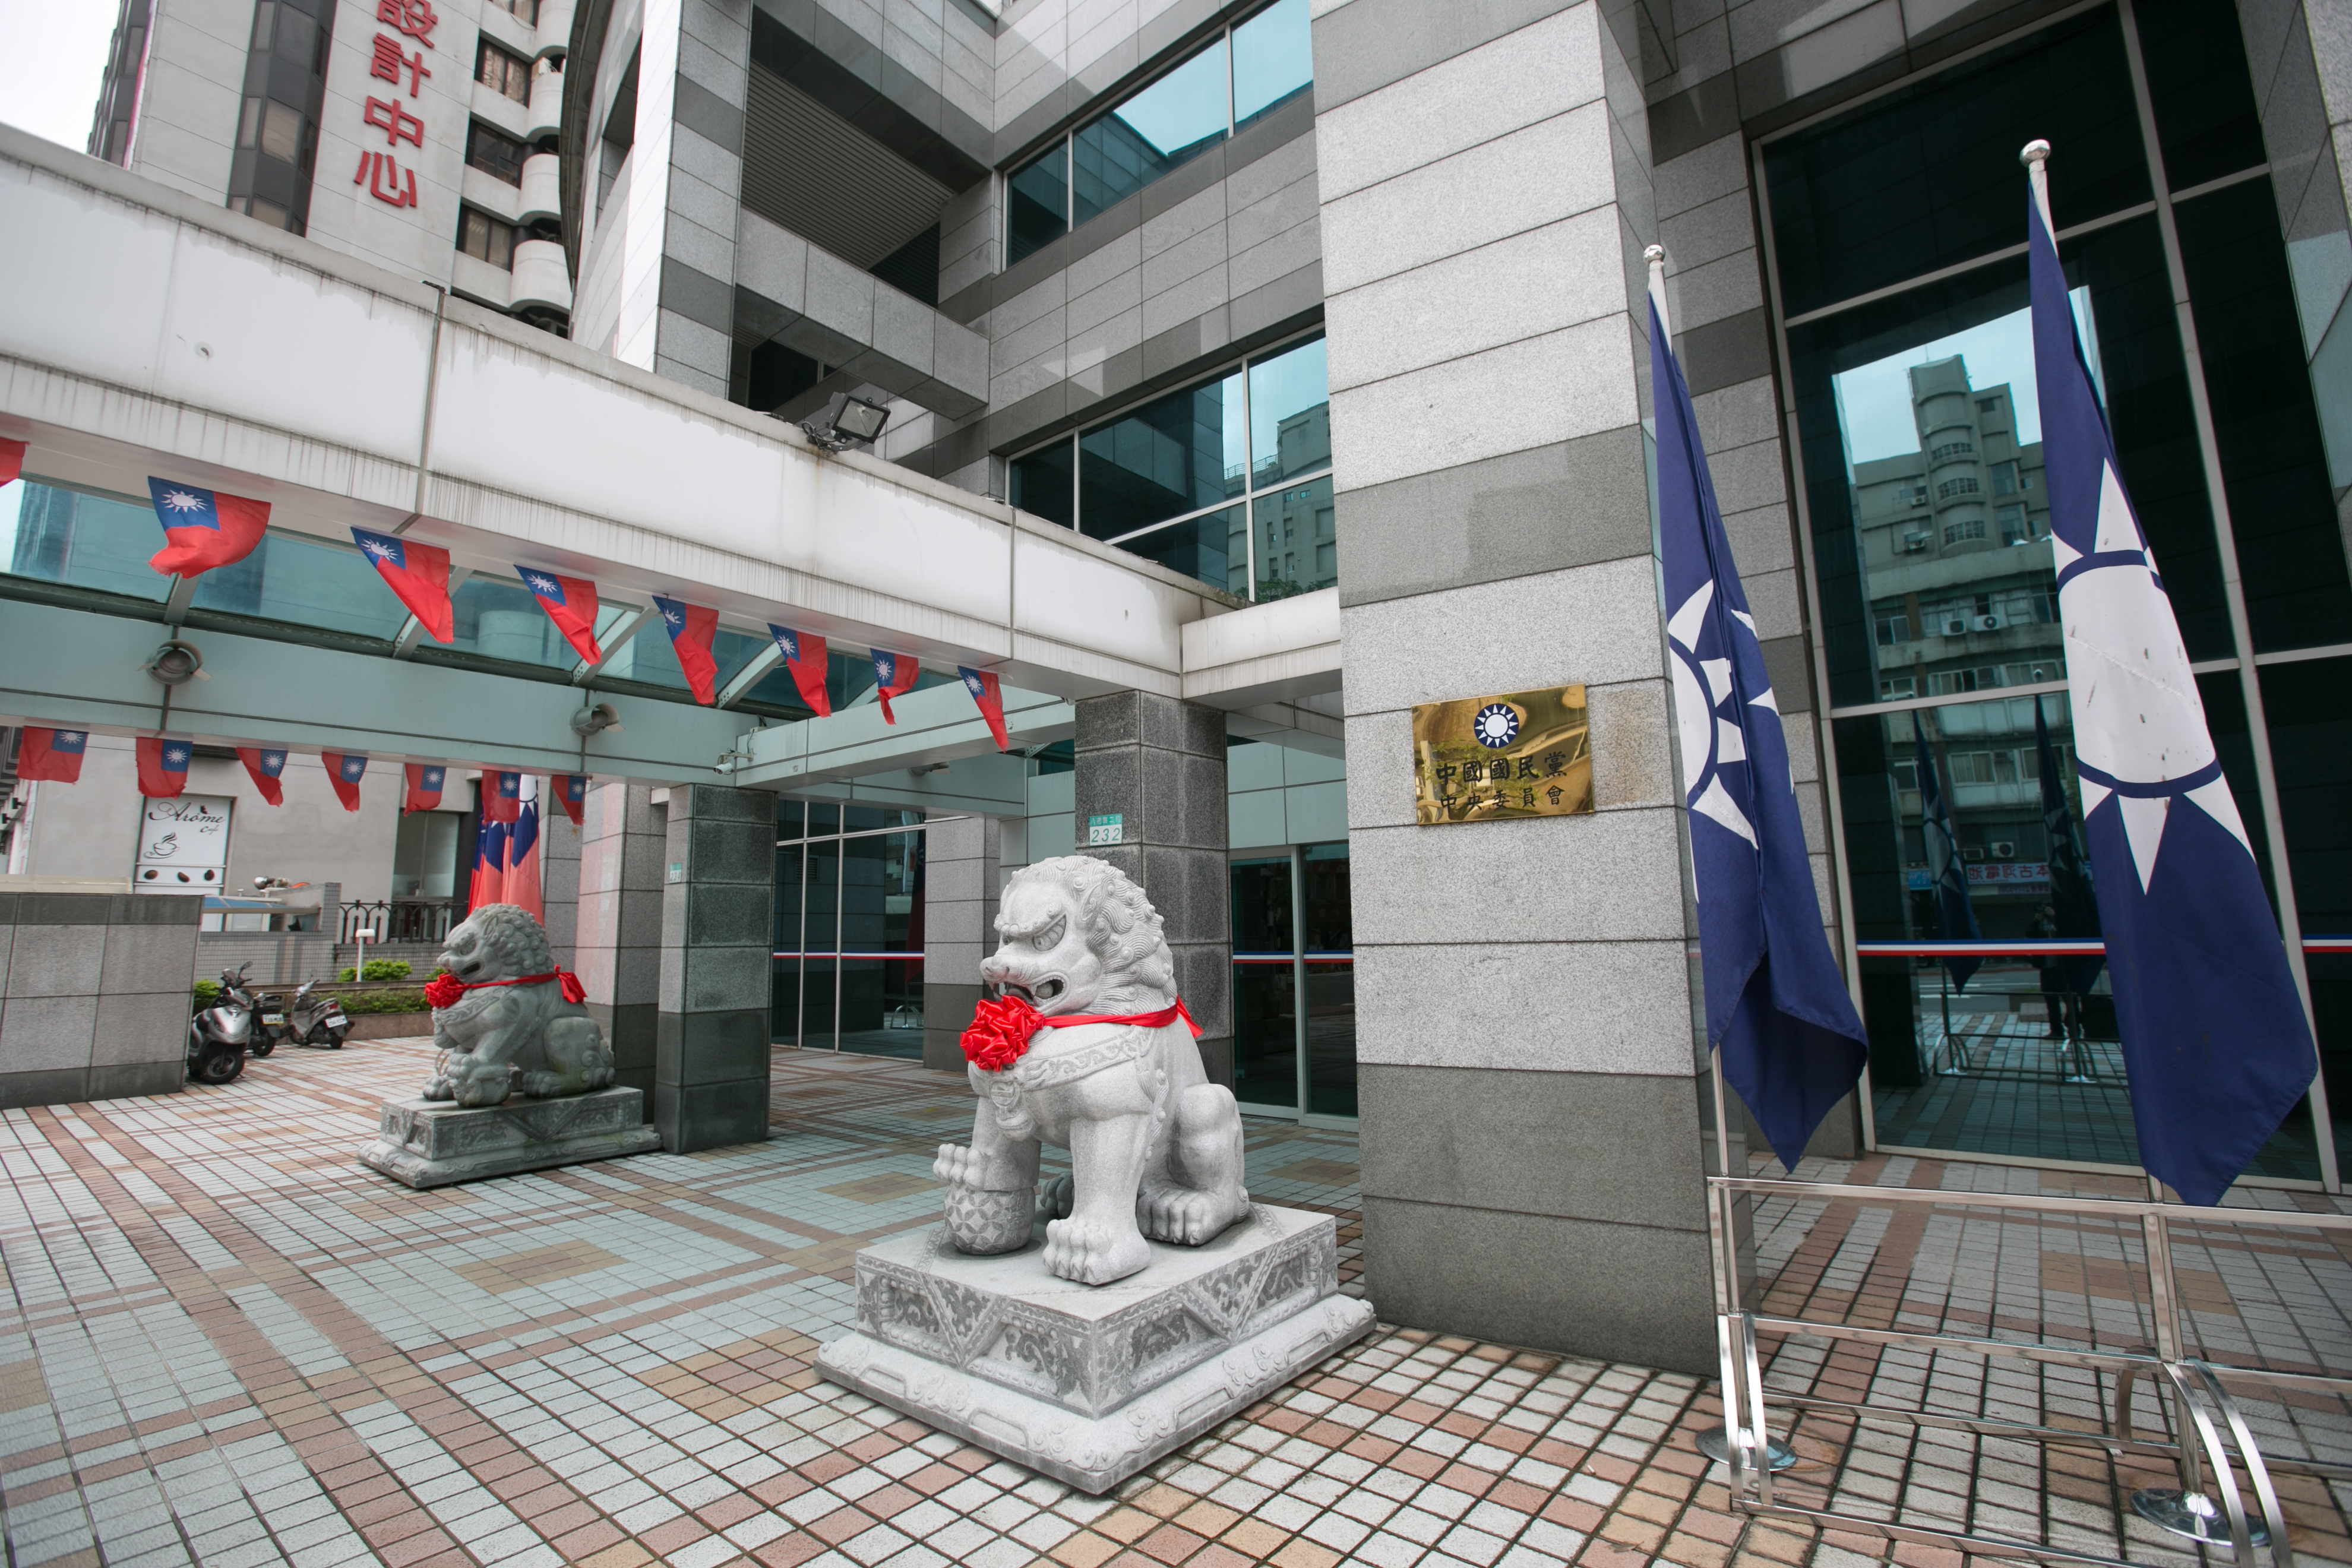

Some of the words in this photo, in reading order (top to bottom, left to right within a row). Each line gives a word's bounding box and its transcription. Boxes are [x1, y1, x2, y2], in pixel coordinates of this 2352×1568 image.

[354, 0, 438, 207] 設計中心
[1436, 751, 1567, 786] 中國國民黨
[1440, 785, 1566, 813] 中央委員會
[1091, 827, 1121, 843] 232
[670, 871, 681, 881] 234
